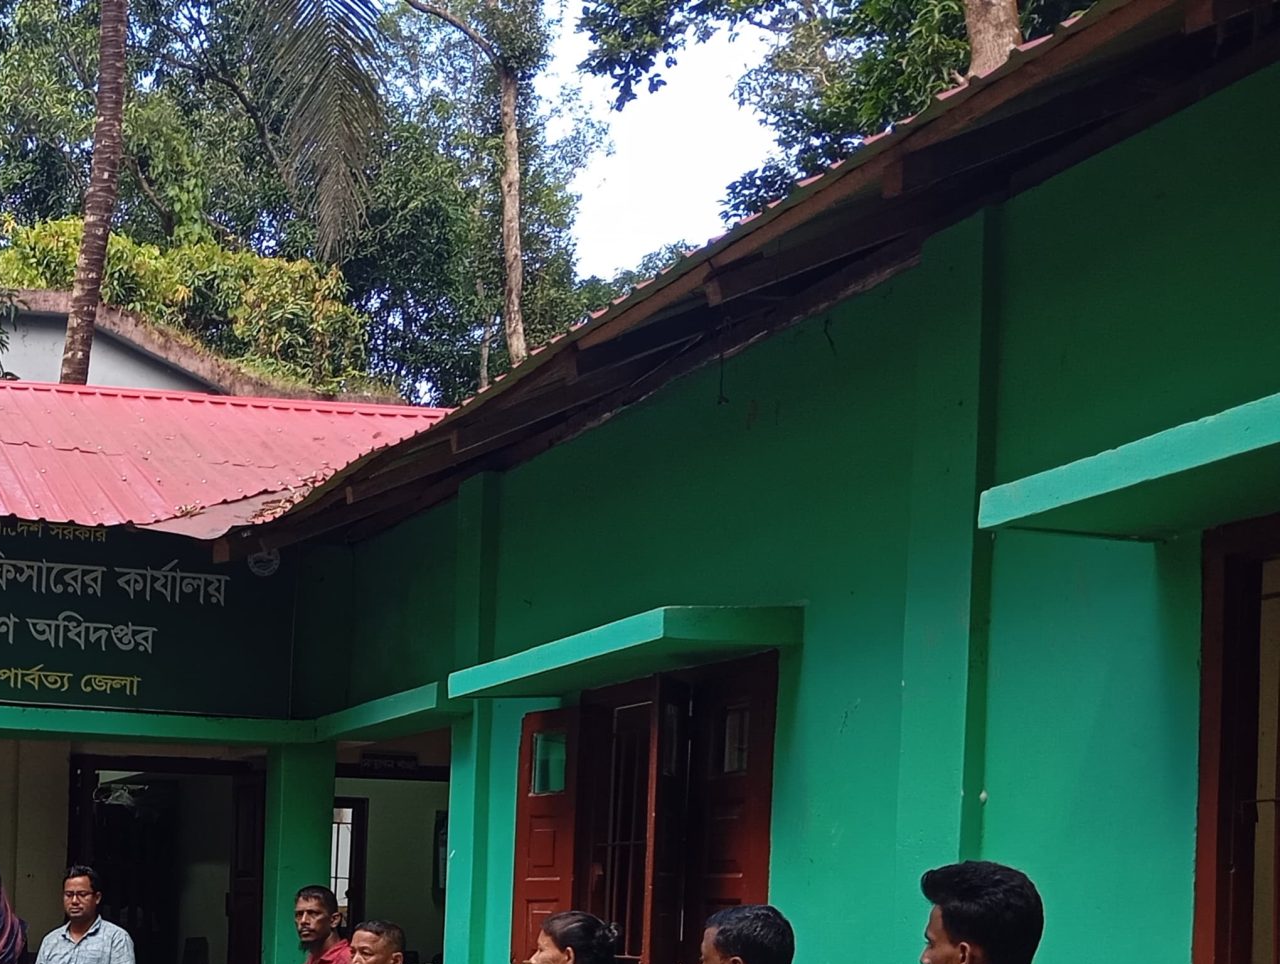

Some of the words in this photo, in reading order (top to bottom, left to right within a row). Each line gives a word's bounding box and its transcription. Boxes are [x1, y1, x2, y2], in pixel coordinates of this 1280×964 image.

[115, 560, 230, 606] কার্যালয়
[26, 611, 158, 653] অধিদপ্তর
[82, 675, 141, 696] জেলা
